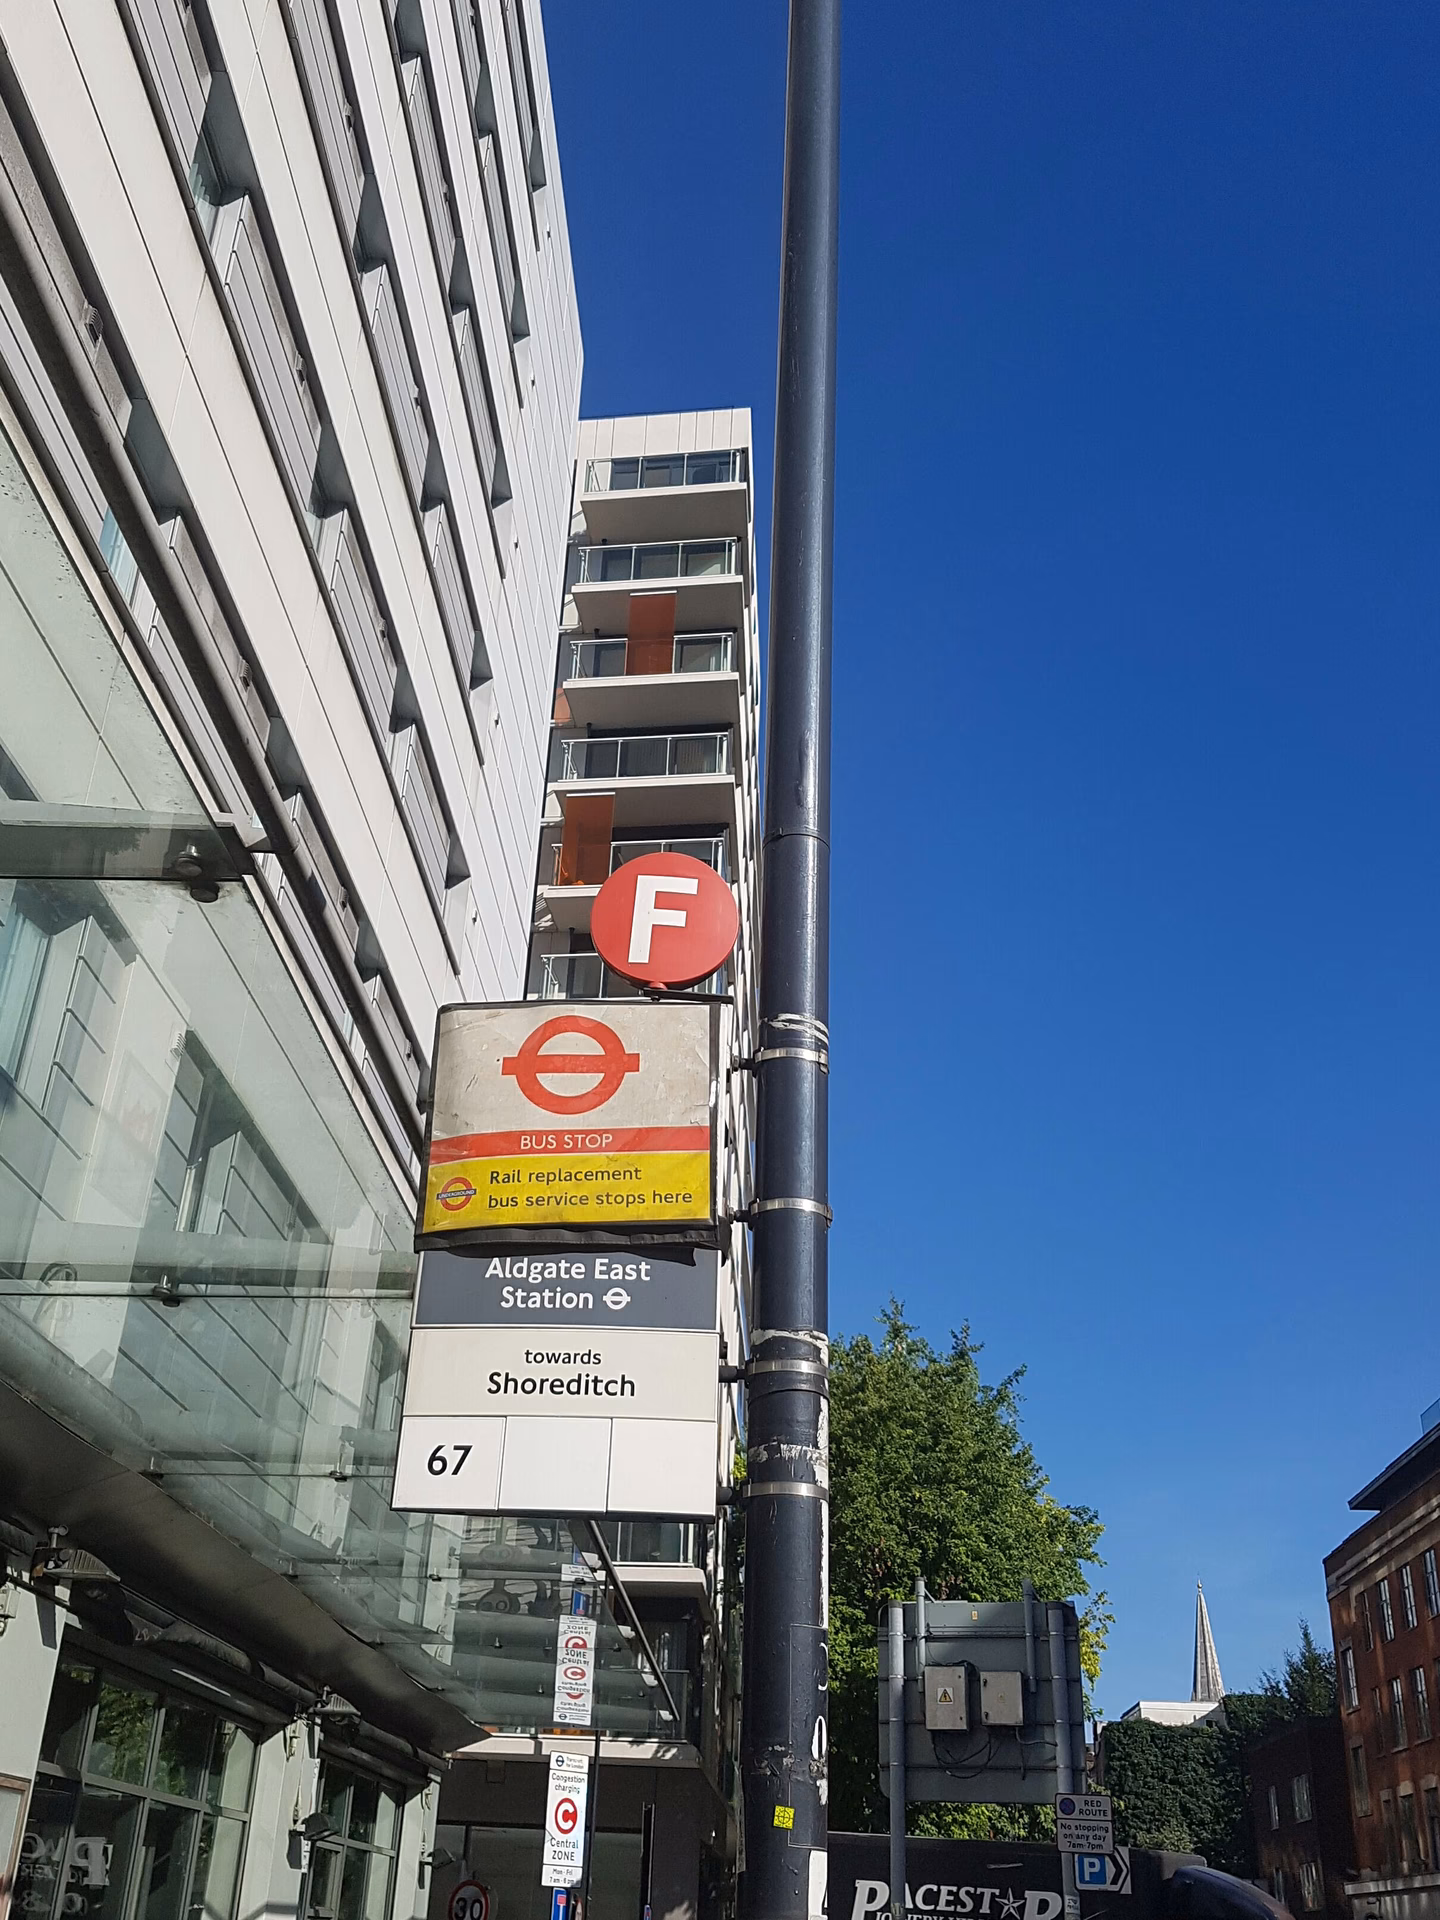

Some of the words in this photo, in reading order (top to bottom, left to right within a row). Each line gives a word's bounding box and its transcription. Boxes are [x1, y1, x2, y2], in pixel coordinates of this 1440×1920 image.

[628, 875, 699, 963] F
[520, 1135, 556, 1150] BUS
[564, 1133, 613, 1149] STOP
[489, 1170, 521, 1185] Rail
[528, 1166, 642, 1186] replacement
[488, 1194, 519, 1209] bus
[525, 1192, 589, 1207] service
[595, 1191, 646, 1209] stops
[652, 1190, 693, 1204] here
[485, 1257, 586, 1283] Aldgate
[594, 1258, 651, 1281] East
[500, 1286, 593, 1309] Station
[524, 1349, 602, 1365] towards
[487, 1372, 636, 1397] Shoreditch
[427, 1445, 473, 1476] 67
[552, 1772, 585, 1783] Congestion
[554, 1783, 580, 1794] charging
[1084, 1800, 1102, 1808] RED
[1079, 1808, 1108, 1817] ROUTE
[1060, 1822, 1072, 1830] No
[1074, 1823, 1109, 1833] stopping
[550, 1837, 579, 1849] Central
[1067, 1841, 1104, 1850] 7am-7pm
[1075, 1833, 1090, 1841] any
[1092, 1833, 1107, 1842] day
[552, 1850, 575, 1861] ZONE
[454, 1897, 484, 1920] 30
